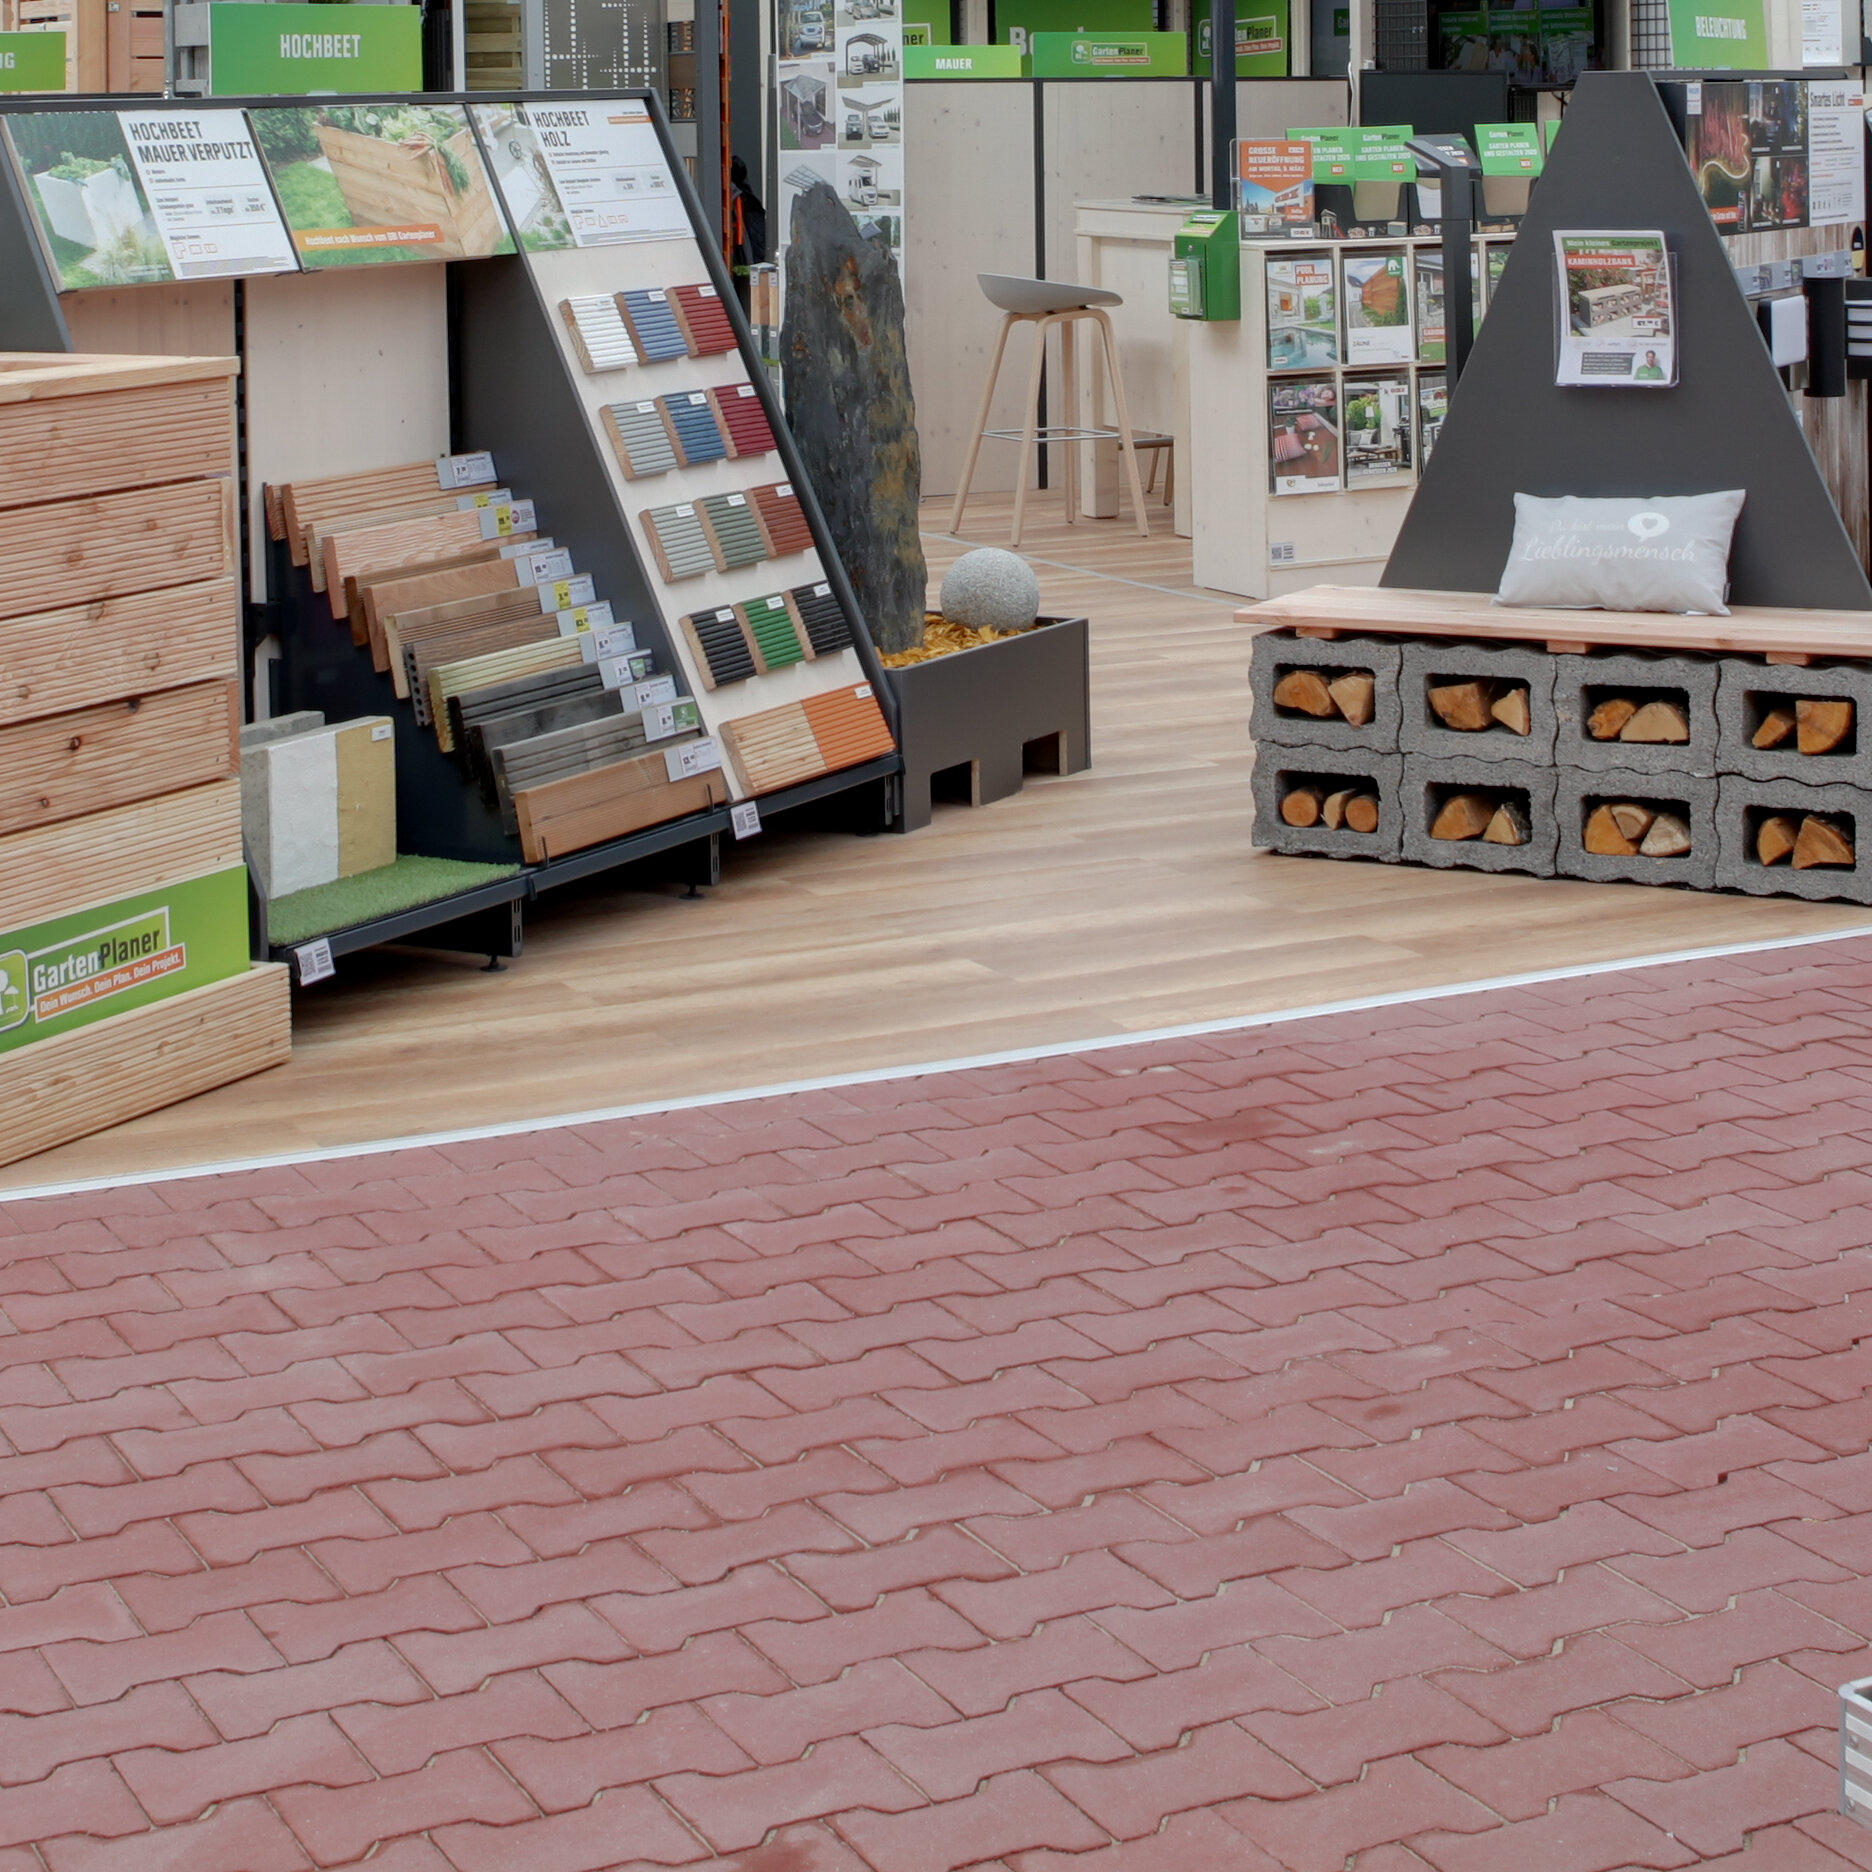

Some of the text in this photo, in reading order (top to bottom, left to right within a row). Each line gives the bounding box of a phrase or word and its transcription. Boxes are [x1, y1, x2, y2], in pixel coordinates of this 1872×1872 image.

[280, 34, 361, 58] HOCHBEET
[1092, 47, 1143, 56] GartenPlaner
[935, 58, 972, 70] MAUER
[533, 110, 590, 128] HOCHBEET
[129, 121, 203, 141] HOCHBEET
[540, 131, 571, 148] HOLZ
[137, 141, 256, 163] MAUER VERPUTZT
[1520, 535, 1699, 566] Lieblingsmensch
[33, 929, 160, 993] GartenPlaner
[40, 953, 182, 1013] Dein Wunsch. Dein Plan. Dein Projekt.
